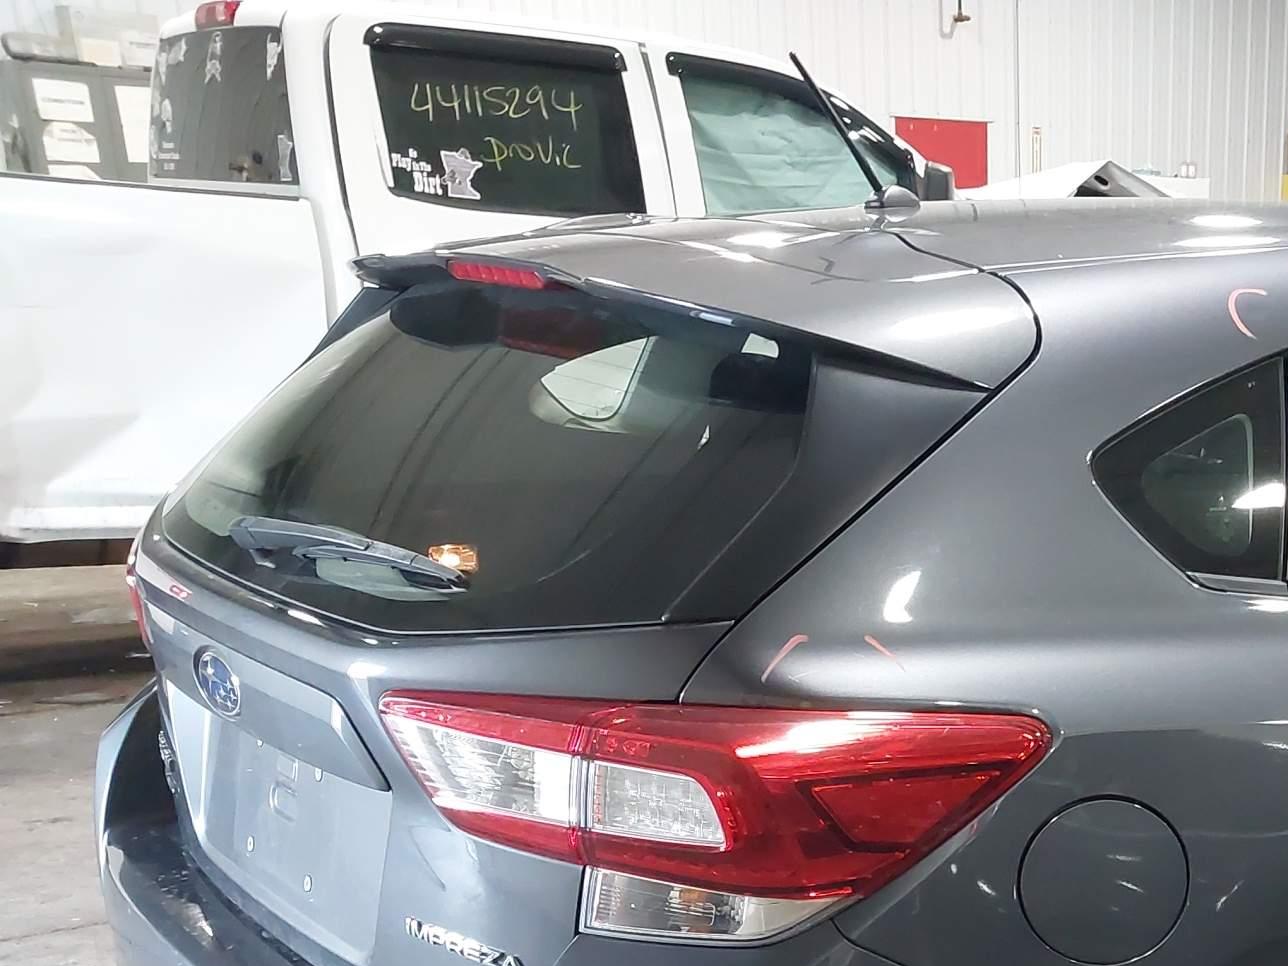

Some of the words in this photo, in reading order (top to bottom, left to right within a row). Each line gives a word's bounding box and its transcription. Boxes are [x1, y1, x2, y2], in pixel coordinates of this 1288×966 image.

[411, 83, 583, 131] 44115294
[391, 153, 412, 172] Play
[413, 171, 443, 195] Dirt
